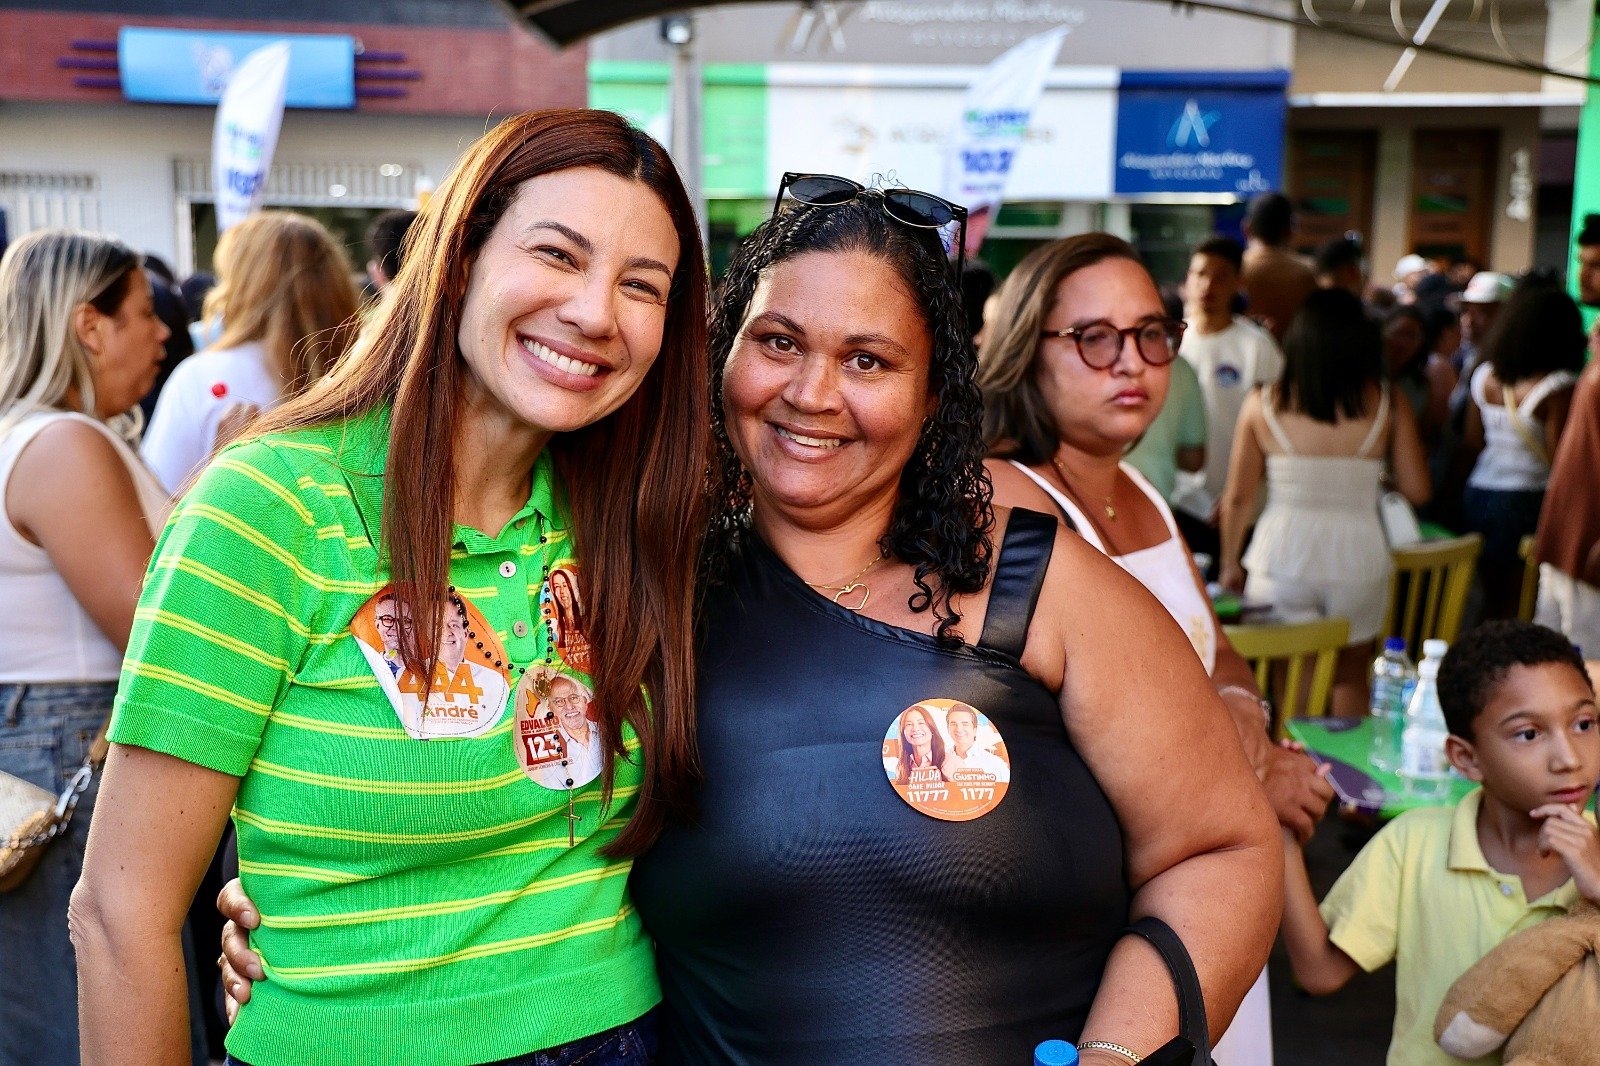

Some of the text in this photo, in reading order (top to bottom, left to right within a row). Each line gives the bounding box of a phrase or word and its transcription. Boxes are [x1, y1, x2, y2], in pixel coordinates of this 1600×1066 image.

[397, 660, 484, 704] 444
[421, 705, 479, 719] André
[526, 735, 561, 761] 123
[908, 769, 941, 783] HILDA
[907, 789, 949, 802] 11777
[960, 788, 994, 800] 1177
